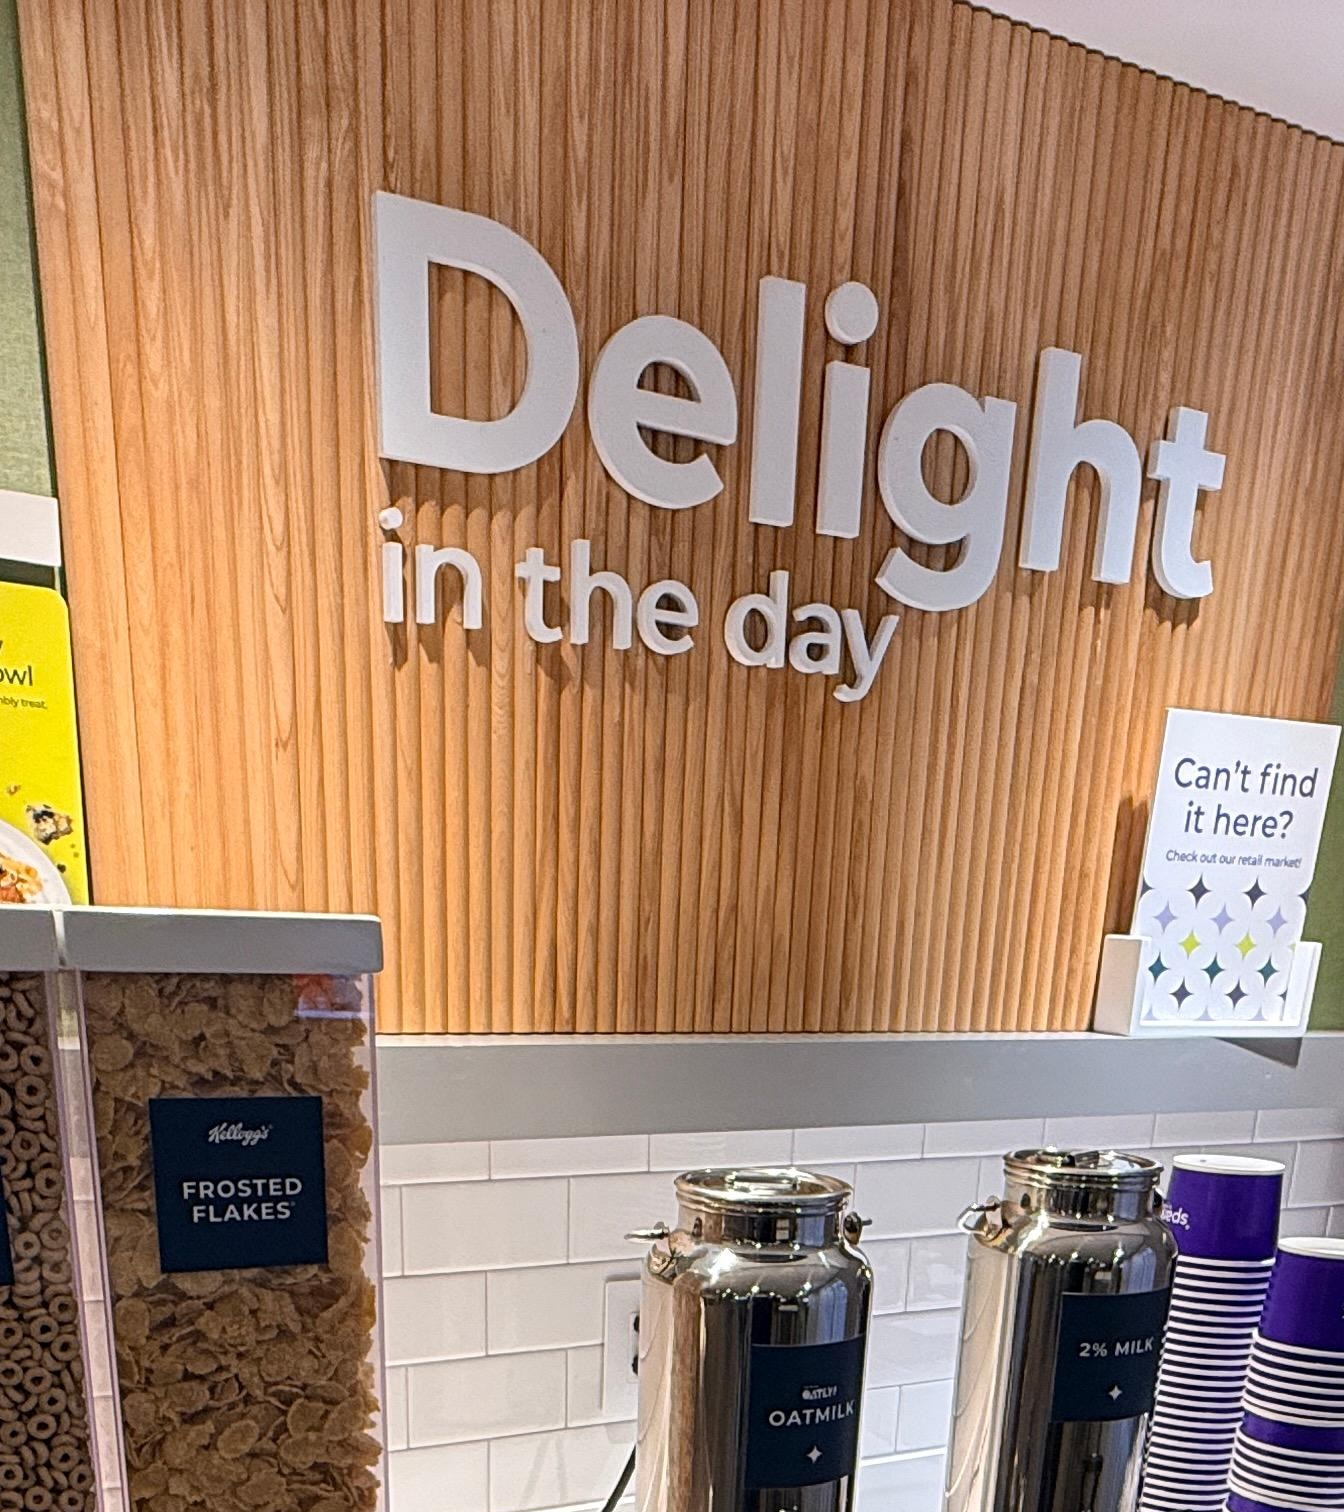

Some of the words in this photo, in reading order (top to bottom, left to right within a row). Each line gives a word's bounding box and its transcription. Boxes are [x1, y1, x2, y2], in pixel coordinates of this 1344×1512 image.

[375, 189, 1226, 612] Delight
[378, 507, 484, 630] in
[515, 538, 699, 656] the
[724, 570, 900, 703] day
[1174, 757, 1252, 793] Can't
[1259, 763, 1319, 798] find
[1184, 800, 1205, 834] it
[1213, 803, 1294, 839] here?
[1166, 849, 1198, 863] Check
[1200, 853, 1217, 863] out
[1219, 855, 1236, 864] our
[1238, 854, 1263, 866] retail
[1264, 857, 1303, 869] market!
[208, 1122, 270, 1146] Kellogg's
[182, 1178, 303, 1200] FROSTED
[193, 1201, 291, 1223] FLAKES
[1079, 1342, 1108, 1357] 2%
[1115, 1335, 1154, 1357] MILK
[769, 1400, 856, 1427] OATMILK
